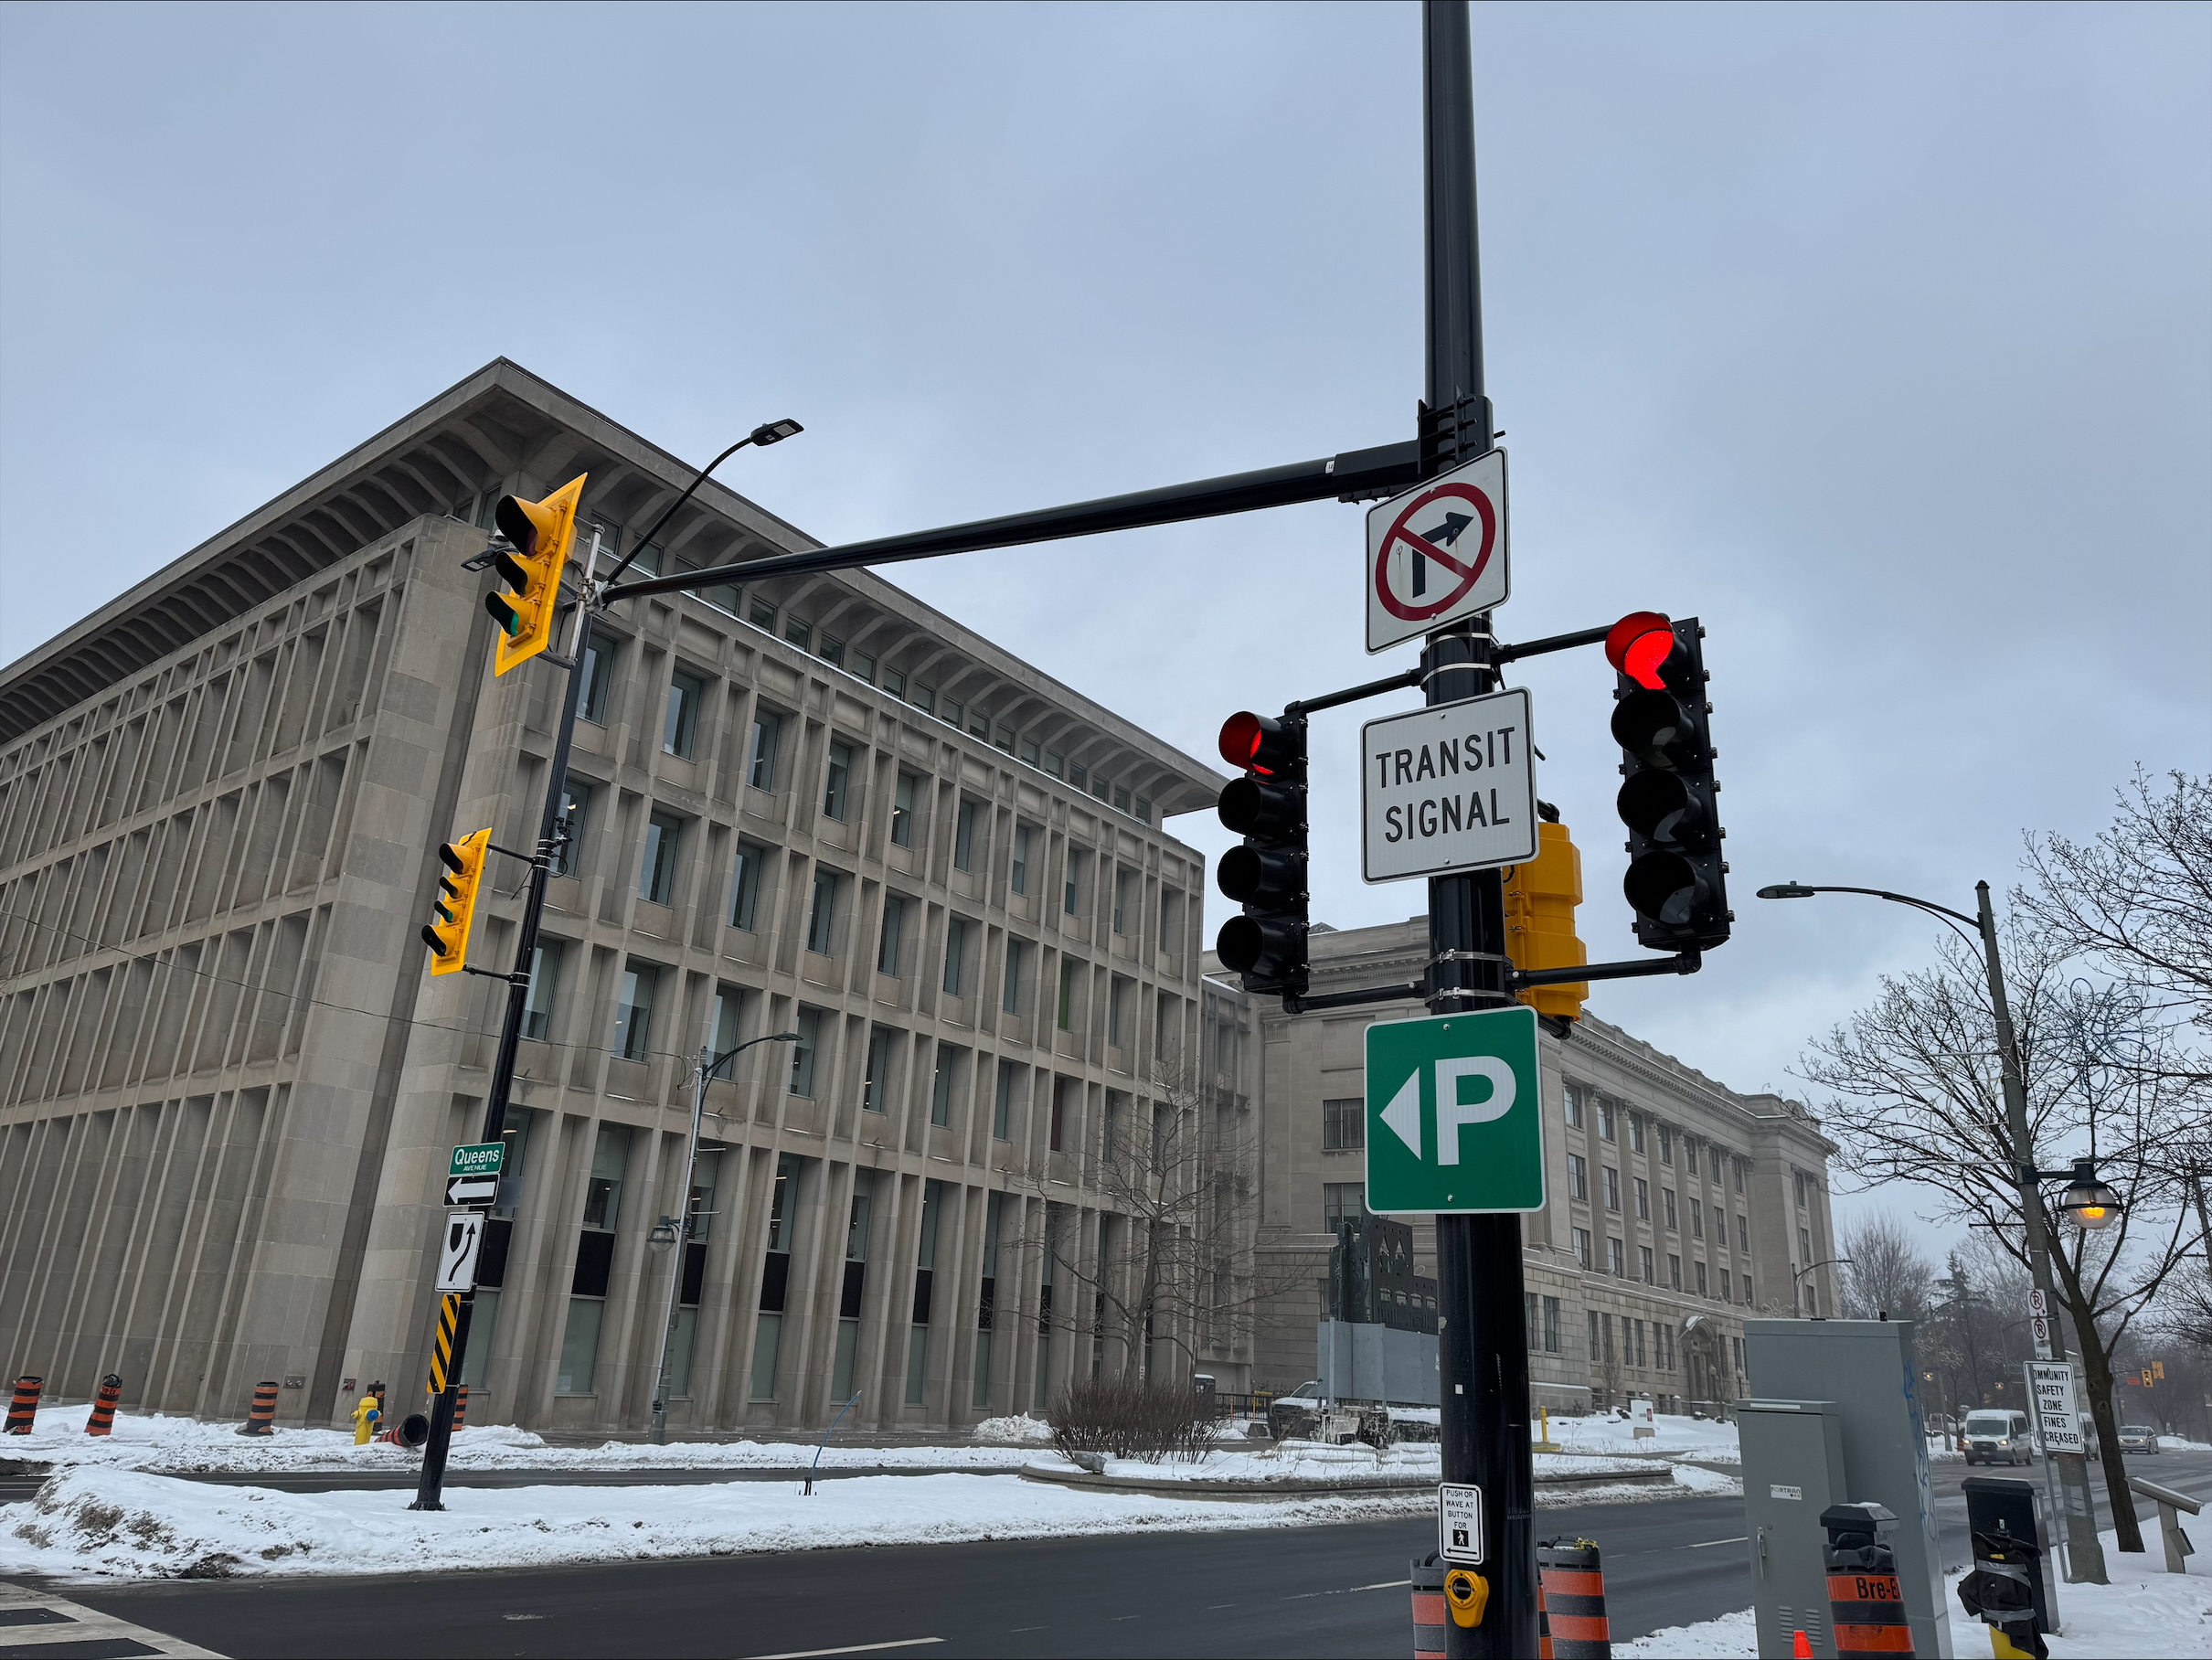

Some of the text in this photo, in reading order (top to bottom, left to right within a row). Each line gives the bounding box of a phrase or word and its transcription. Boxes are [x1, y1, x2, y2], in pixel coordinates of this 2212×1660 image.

[1376, 727, 1515, 788] TRANSIT
[1385, 788, 1510, 843] SIGNAL
[1435, 1056, 1517, 1165] P
[455, 1148, 499, 1165] Queens
[2037, 1384, 2064, 1396] SAFETY
[2042, 1399, 2063, 1411] ZONE
[2044, 1416, 2067, 1428] FINES
[1446, 1500, 1463, 1508] WAVE
[1448, 1510, 1473, 1519] BUTTON
[1454, 1521, 1467, 1529] FOR
